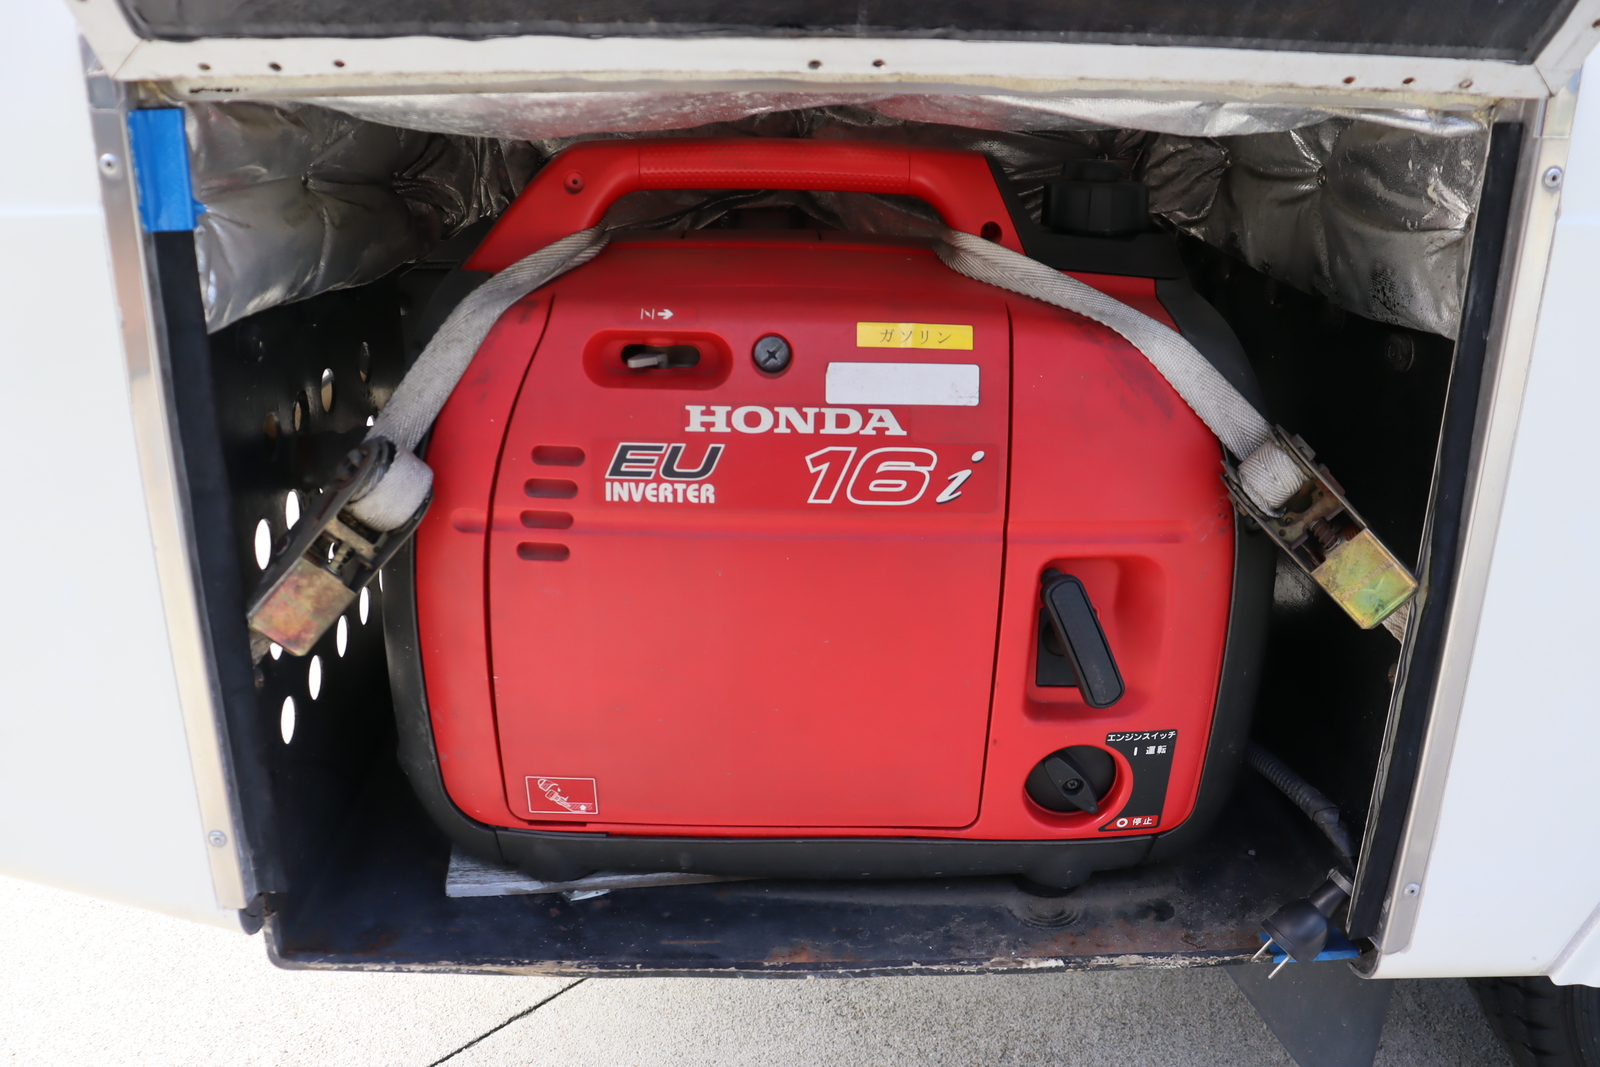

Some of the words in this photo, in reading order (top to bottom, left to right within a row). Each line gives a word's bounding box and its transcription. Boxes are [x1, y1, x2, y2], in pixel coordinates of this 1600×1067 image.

[879, 327, 952, 345] ガソリン
[684, 405, 908, 436] HONDA
[604, 442, 726, 480] EU
[605, 481, 716, 504] INVERTER
[1107, 731, 1176, 742] エンジンスイッチ
[1145, 745, 1167, 755] 運転
[1132, 817, 1152, 825] 停止
